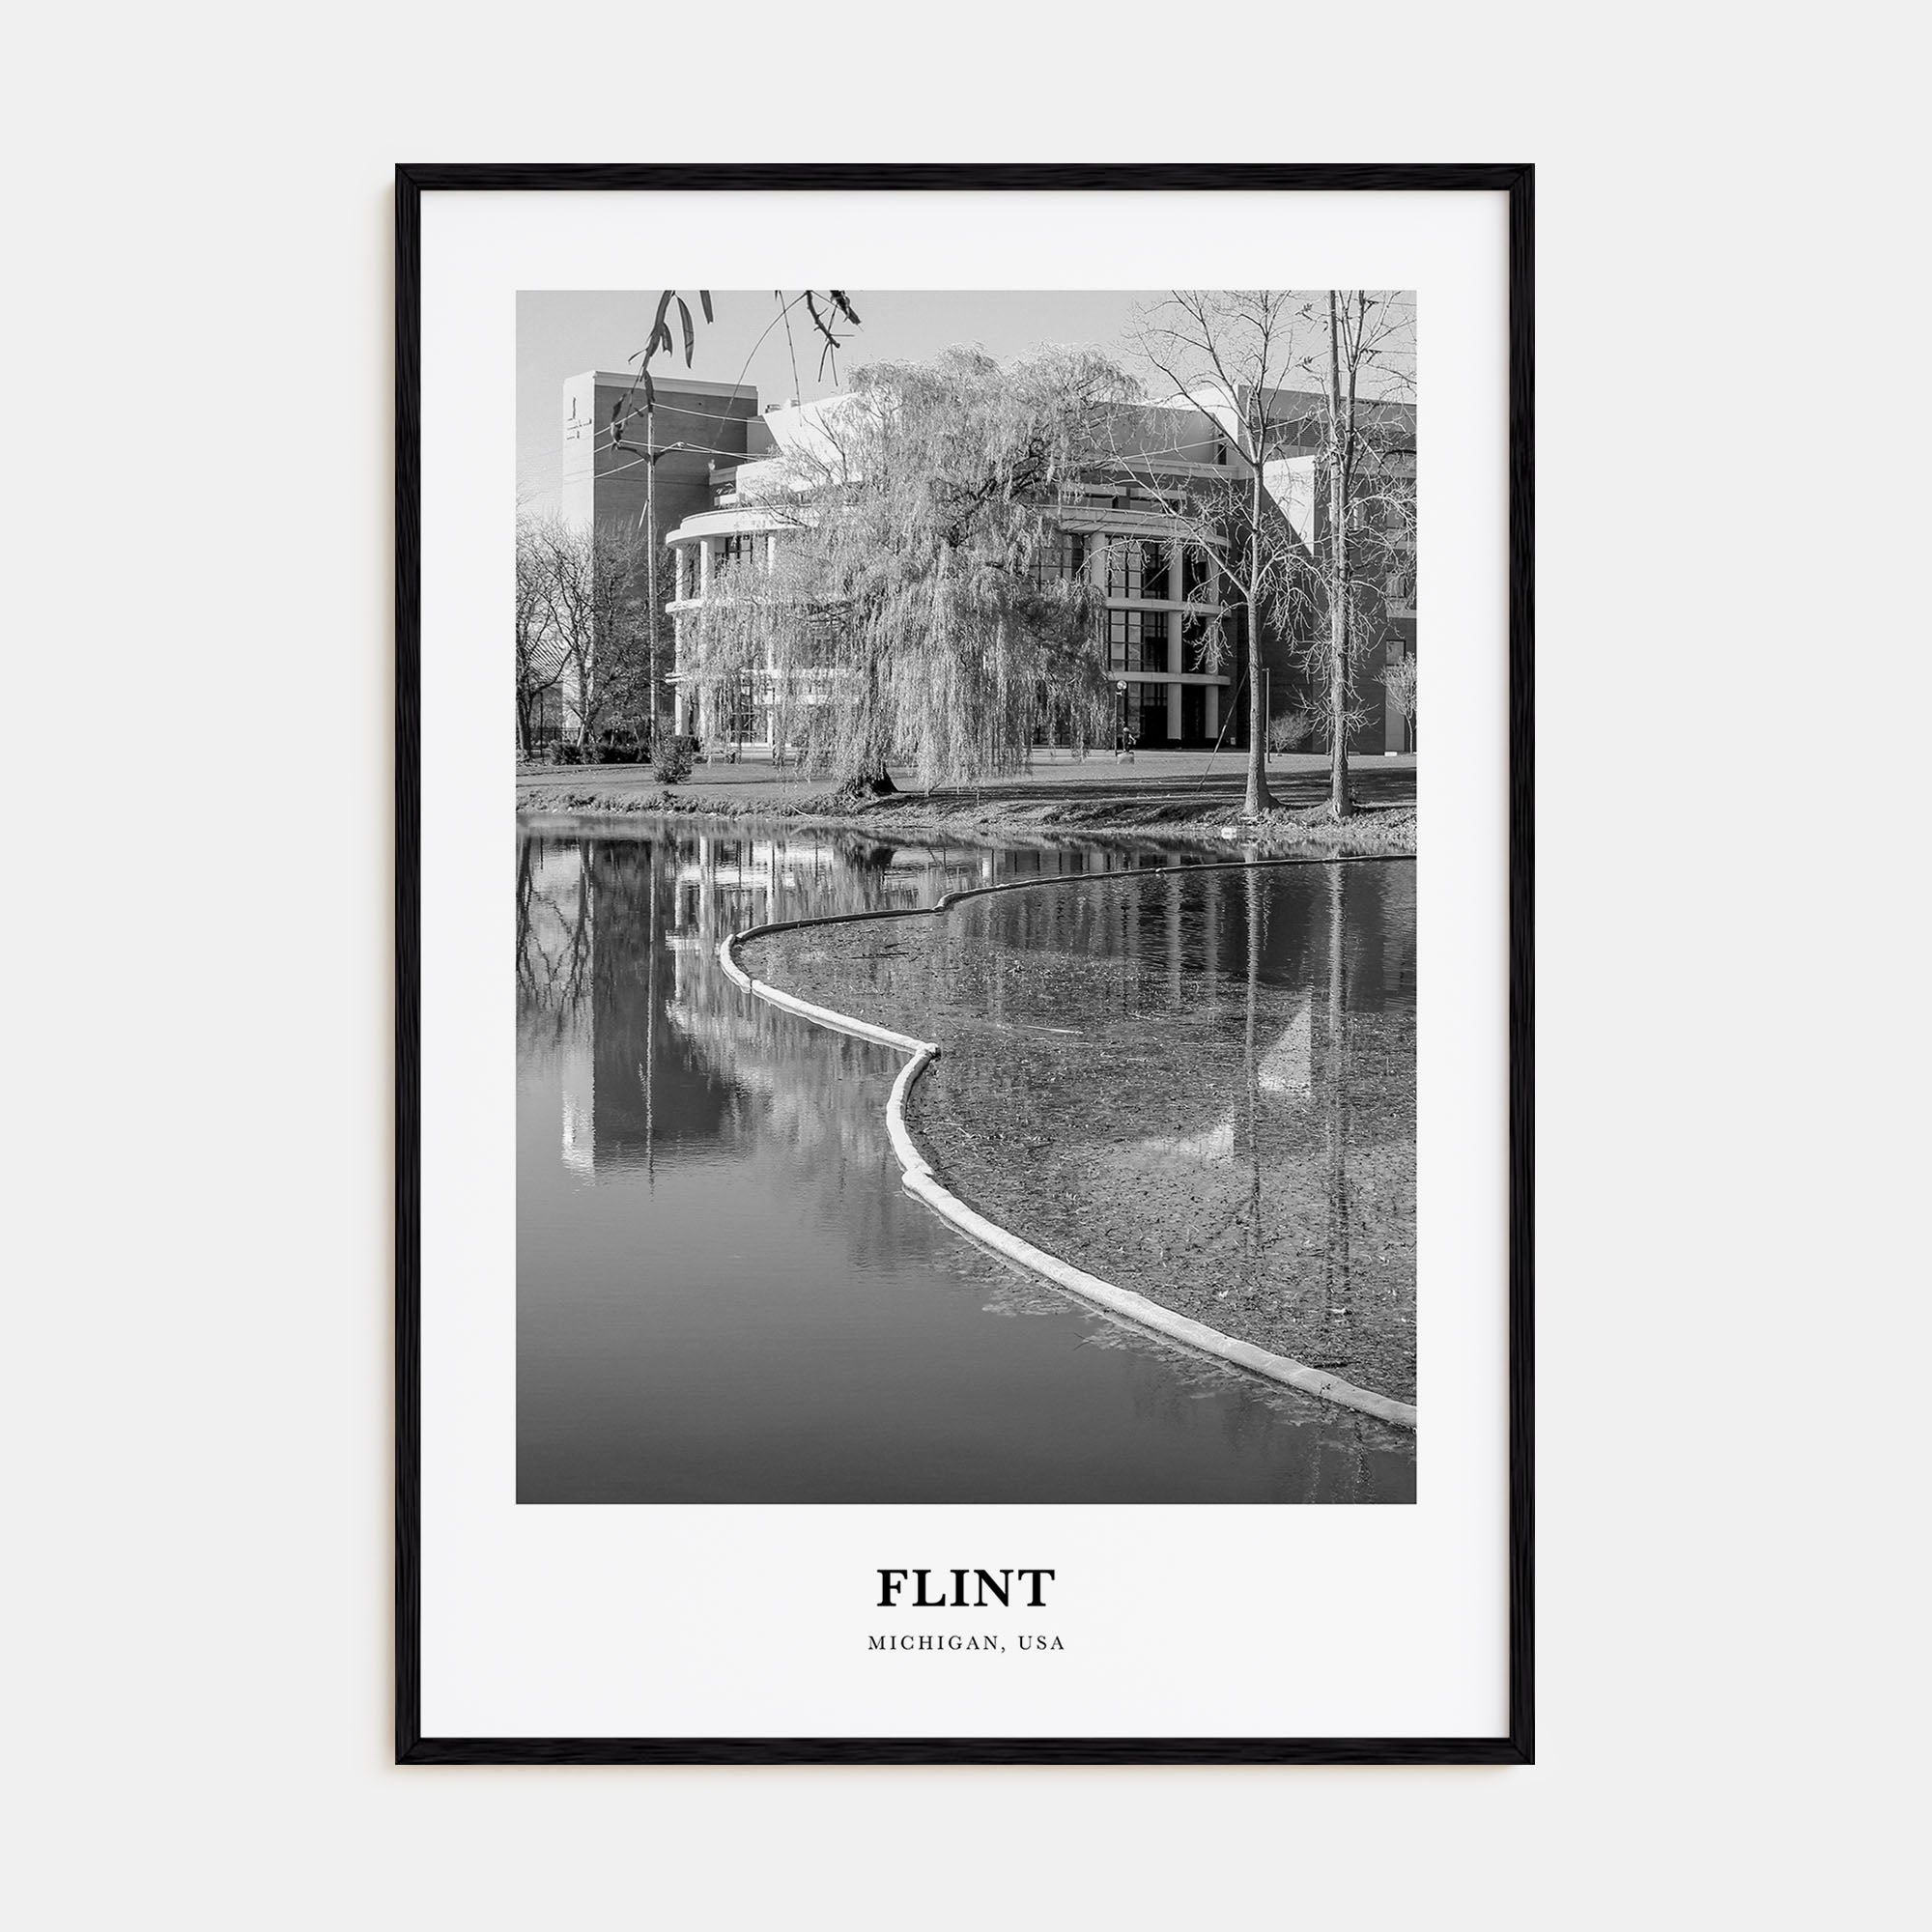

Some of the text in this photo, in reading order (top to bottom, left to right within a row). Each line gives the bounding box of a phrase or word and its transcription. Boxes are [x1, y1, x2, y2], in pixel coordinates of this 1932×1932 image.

[876, 1569, 1056, 1607] FLINT
[867, 1634, 1065, 1654] MICHIGAN, USA
